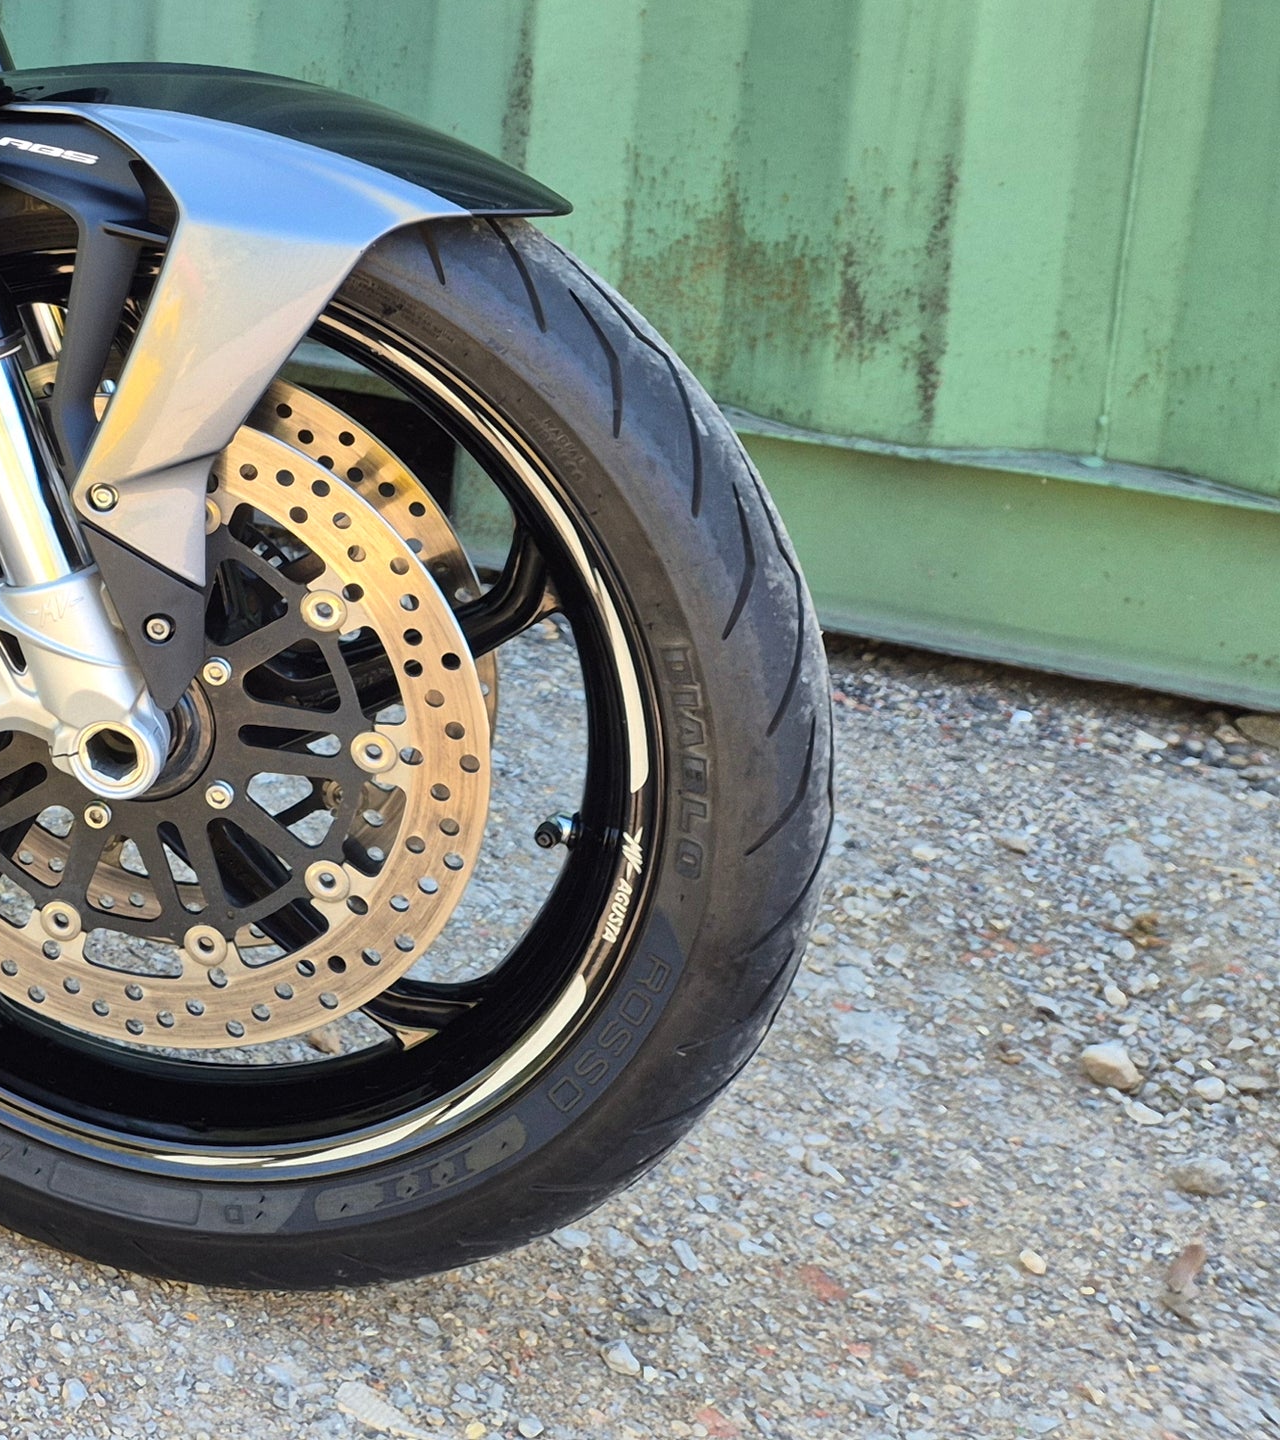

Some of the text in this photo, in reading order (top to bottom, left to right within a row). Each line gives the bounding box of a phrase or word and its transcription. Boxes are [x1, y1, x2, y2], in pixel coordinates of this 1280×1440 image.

[659, 642, 713, 881] DIABLO
[601, 876, 634, 945] AGUSTA
[546, 953, 673, 1115] ROSSO
